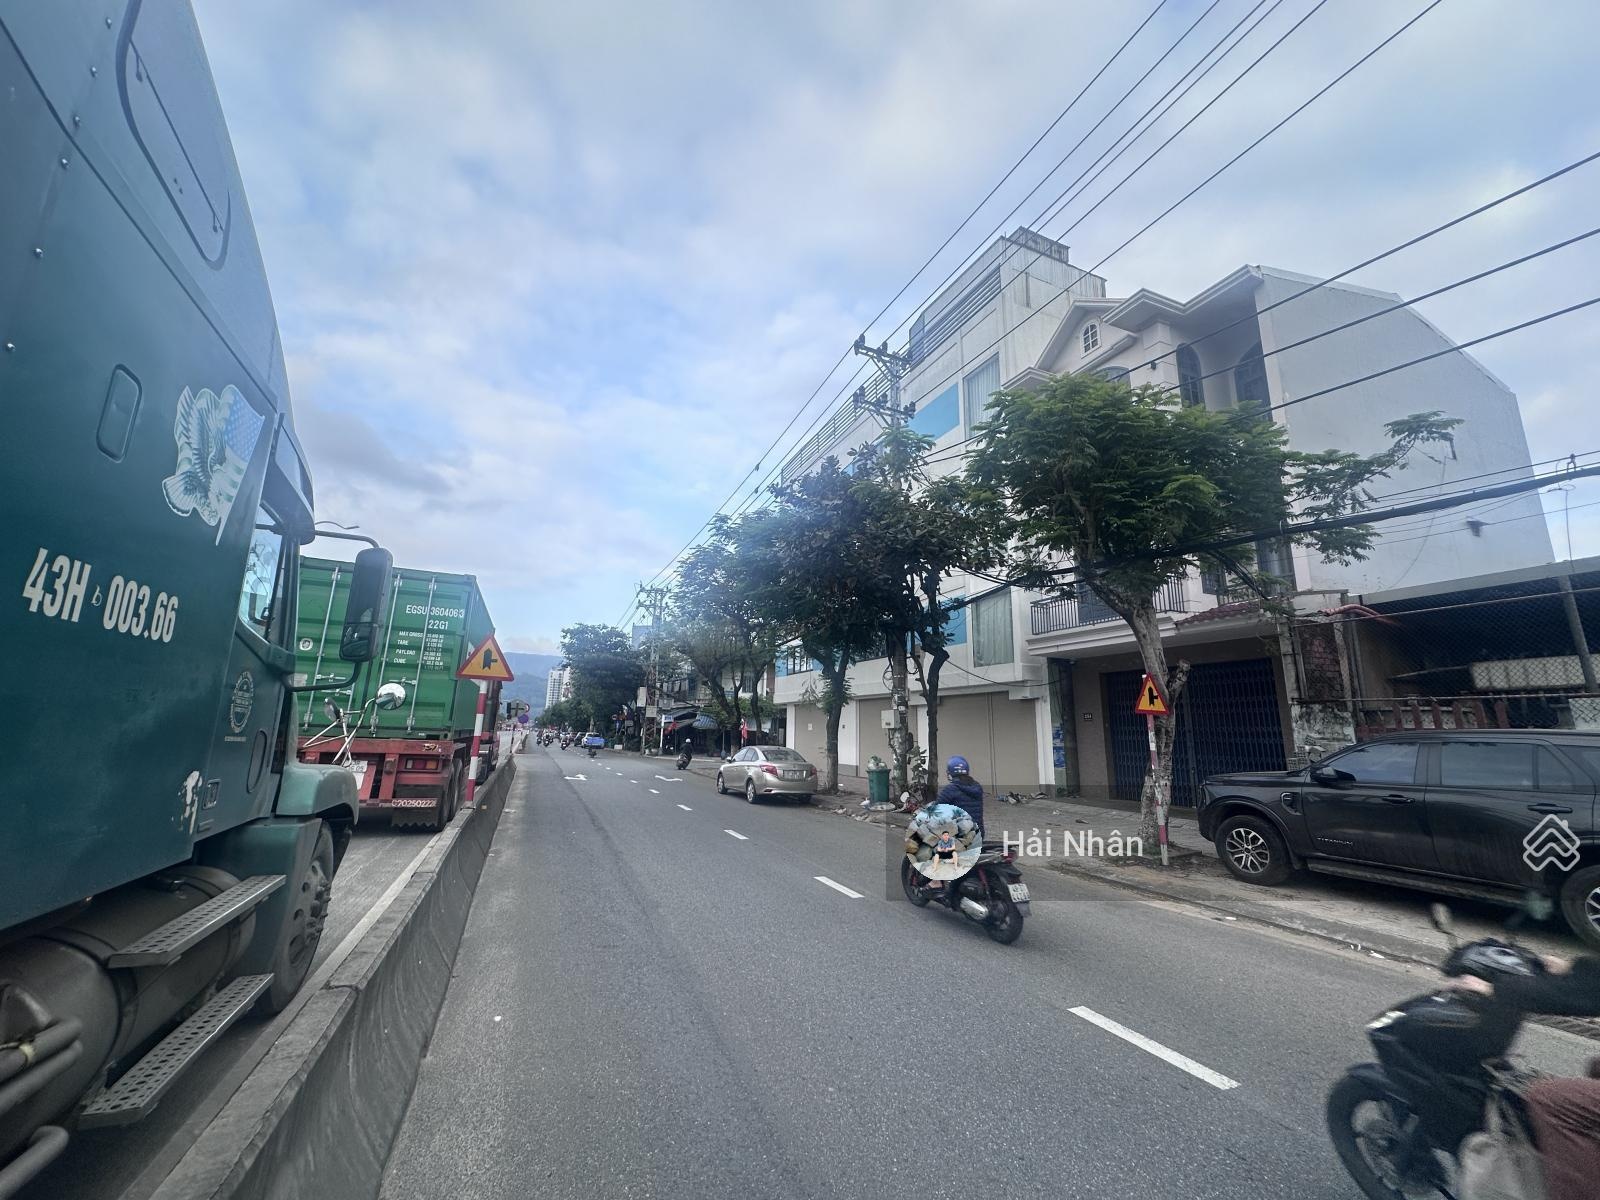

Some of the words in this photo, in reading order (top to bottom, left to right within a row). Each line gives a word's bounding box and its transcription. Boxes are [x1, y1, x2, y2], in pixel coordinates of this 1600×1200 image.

[22, 547, 92, 623] 43H
[103, 575, 179, 643] 003.66
[406, 604, 428, 615] EGSU
[428, 620, 448, 630] 22G1
